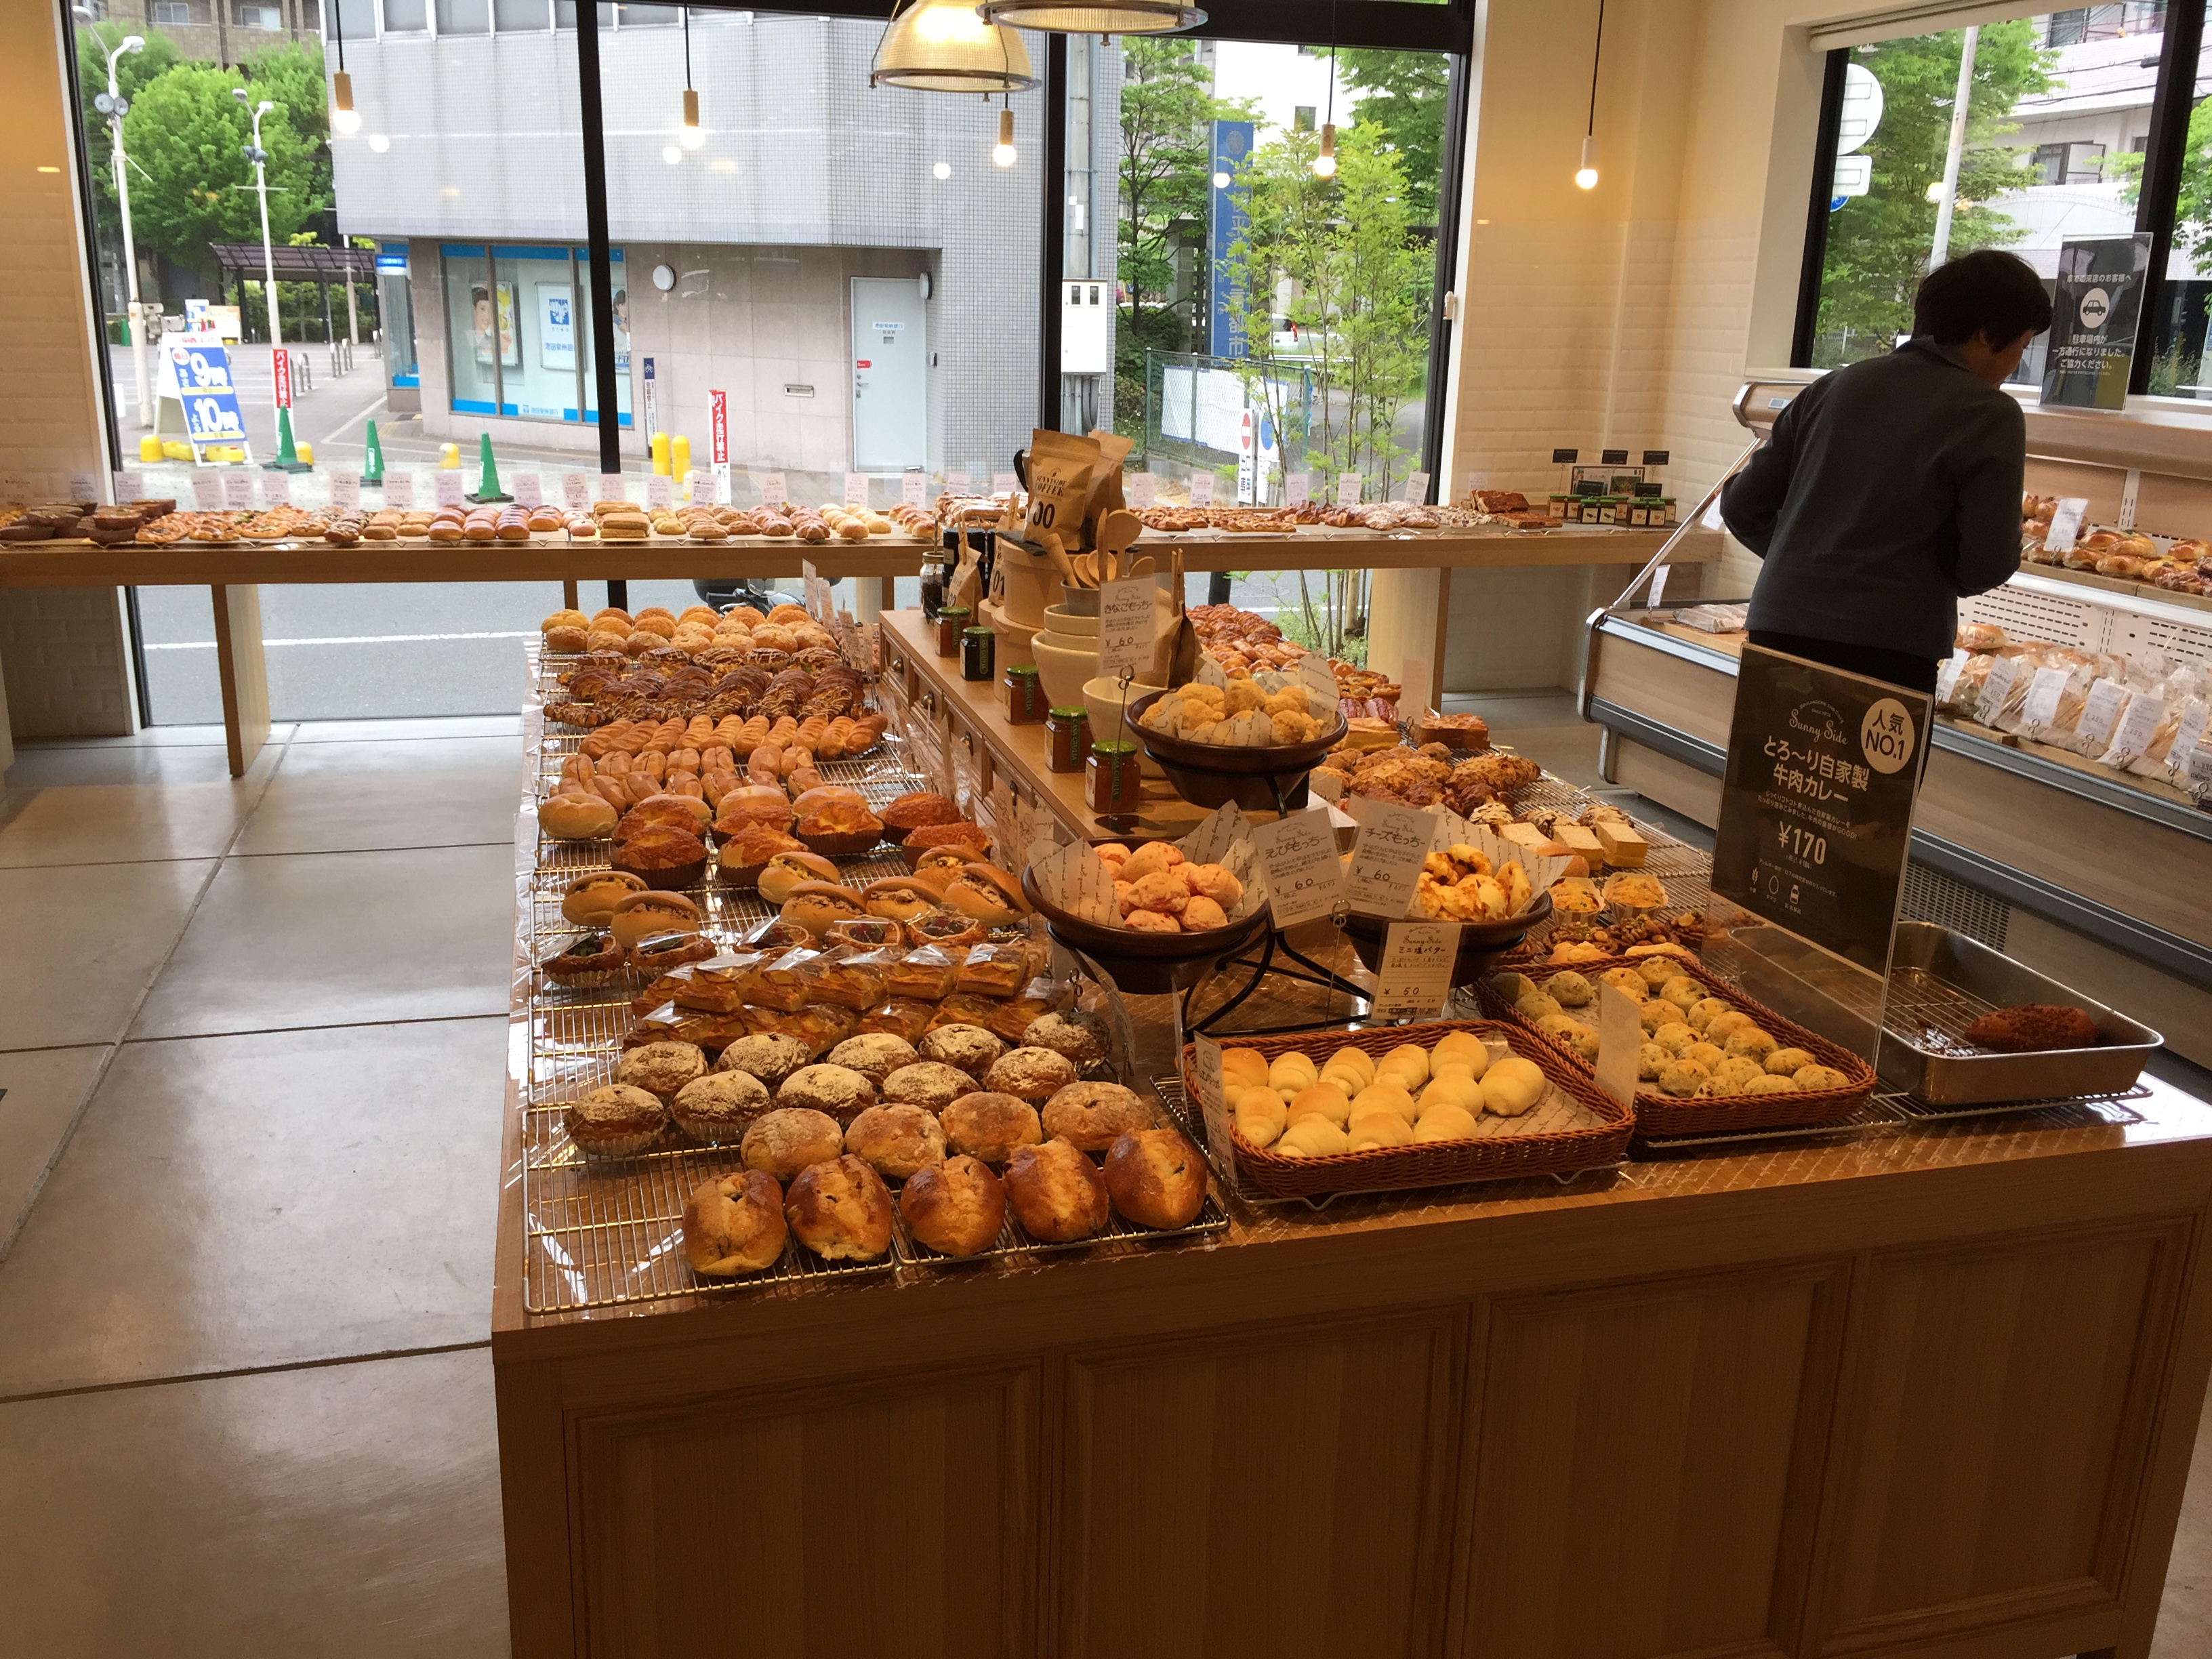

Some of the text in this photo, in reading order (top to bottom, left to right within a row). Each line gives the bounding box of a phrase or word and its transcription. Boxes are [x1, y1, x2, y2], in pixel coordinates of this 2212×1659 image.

[2068, 274, 2131, 283] 車でご来店のお客様へ
[2072, 334, 2108, 345] 駐車場内が
[2052, 346, 2125, 357] 一方通行になりました。
[2060, 359, 2112, 370] ご協力ください。
[714, 394, 725, 462] バイク走行禁止
[1035, 483, 1065, 497] COFFEE
[1104, 600, 1153, 614] きなこもっちー
[1119, 636, 1134, 647] 60
[1789, 708, 1849, 745] Sunny Side
[1872, 709, 1905, 736] 人気
[1071, 719, 1080, 761] CASA GIULIA
[1866, 729, 1905, 761] NO.1
[1773, 762, 1849, 802] 牛肉カレー
[1365, 827, 1426, 848] チーズもっちー
[1778, 821, 1826, 865] ¥170
[1265, 836, 1327, 859] えびもっちー
[1356, 865, 1391, 881] ¥ 60
[1294, 878, 1313, 890] 60
[1398, 946, 1446, 955] ミニ塩バター
[1404, 987, 1420, 996] 50
